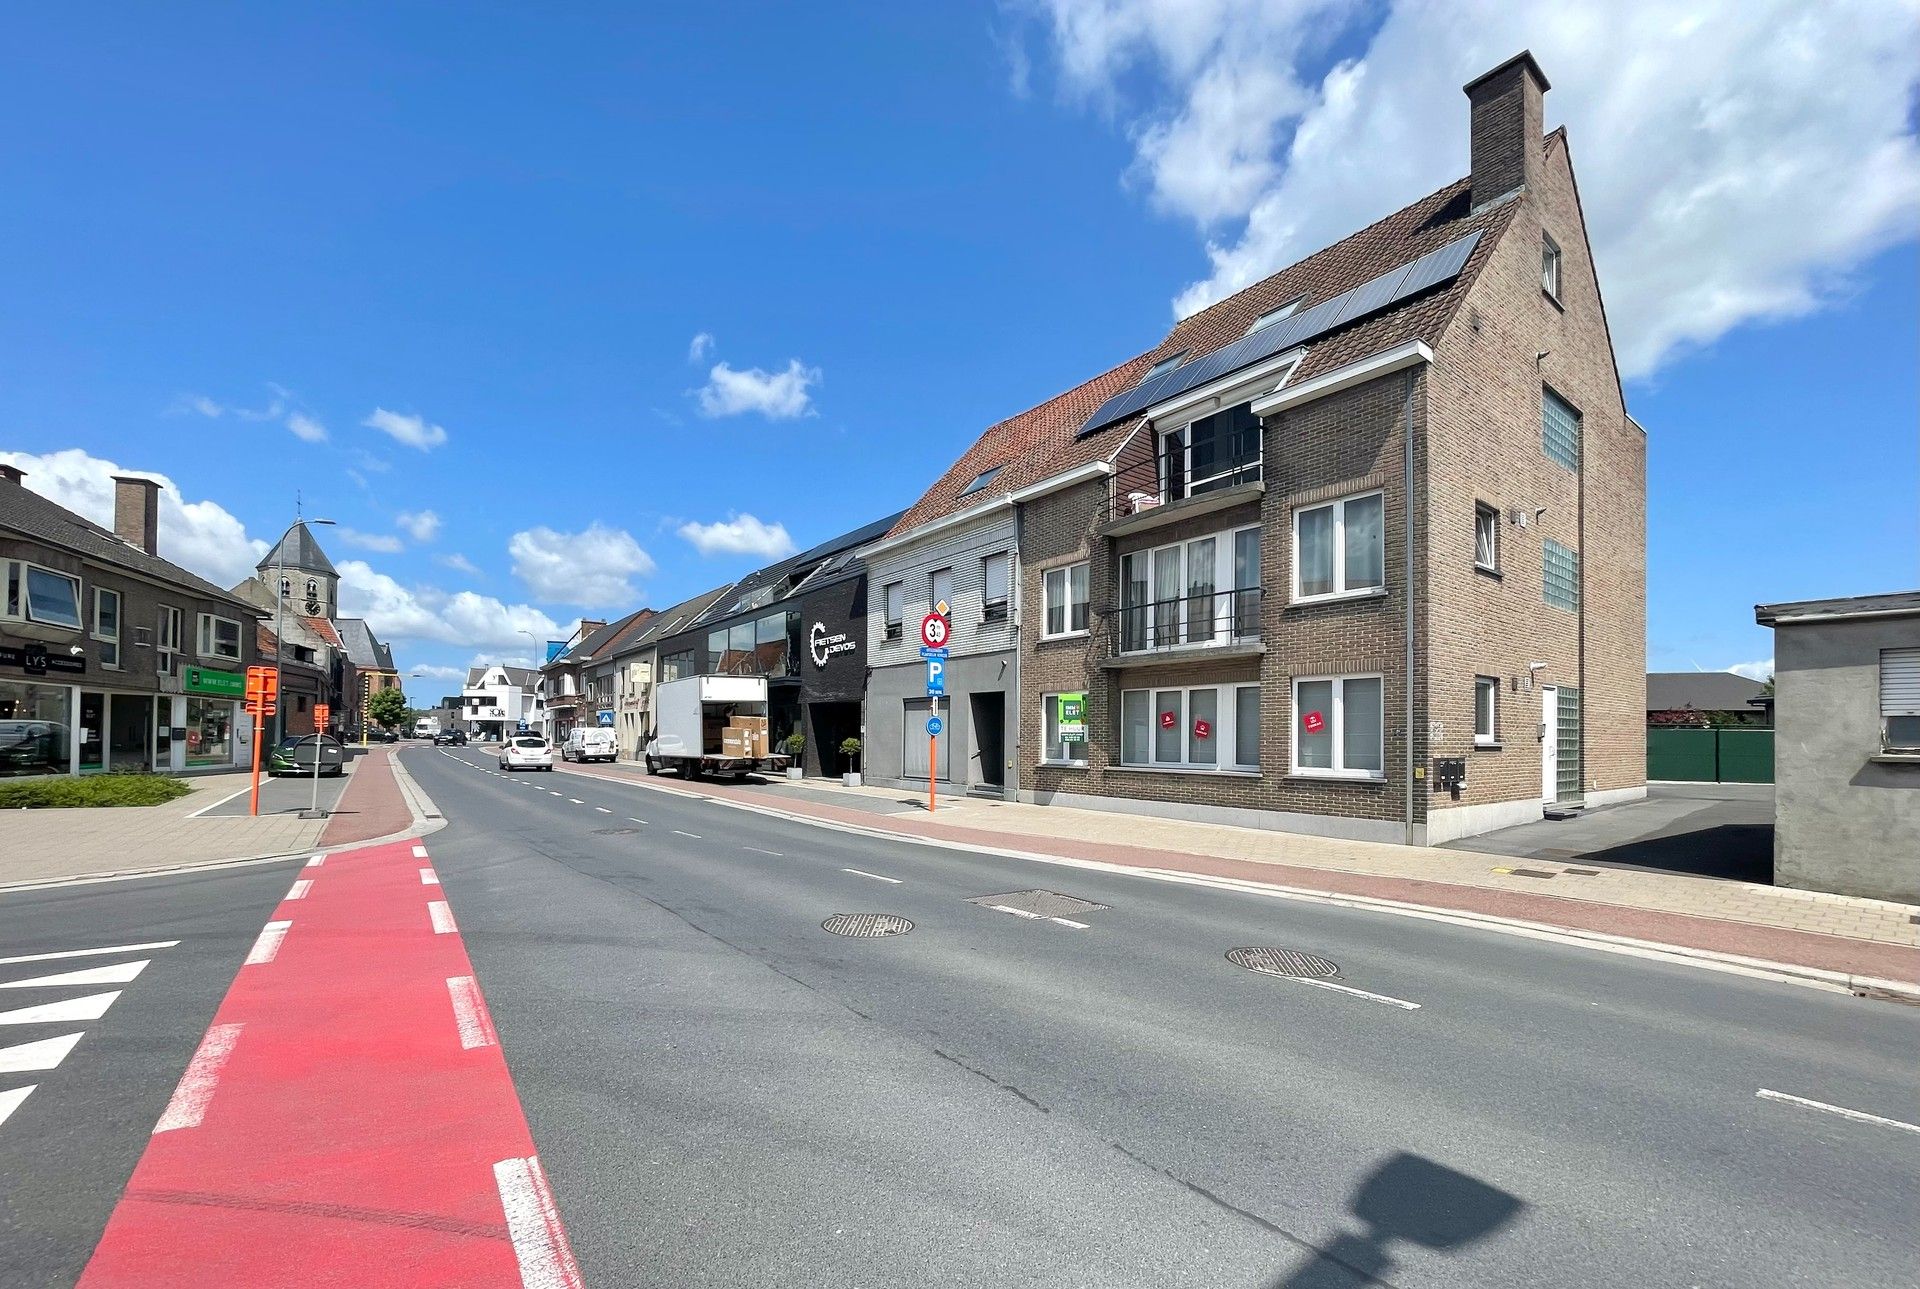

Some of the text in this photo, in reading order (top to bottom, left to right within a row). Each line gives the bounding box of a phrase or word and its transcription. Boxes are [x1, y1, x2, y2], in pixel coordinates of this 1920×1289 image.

[930, 623, 936, 638] 3
[815, 633, 846, 647] FIETSEN
[829, 641, 856, 654] DEVOS
[26, 655, 47, 667] LYS
[929, 662, 942, 683] P
